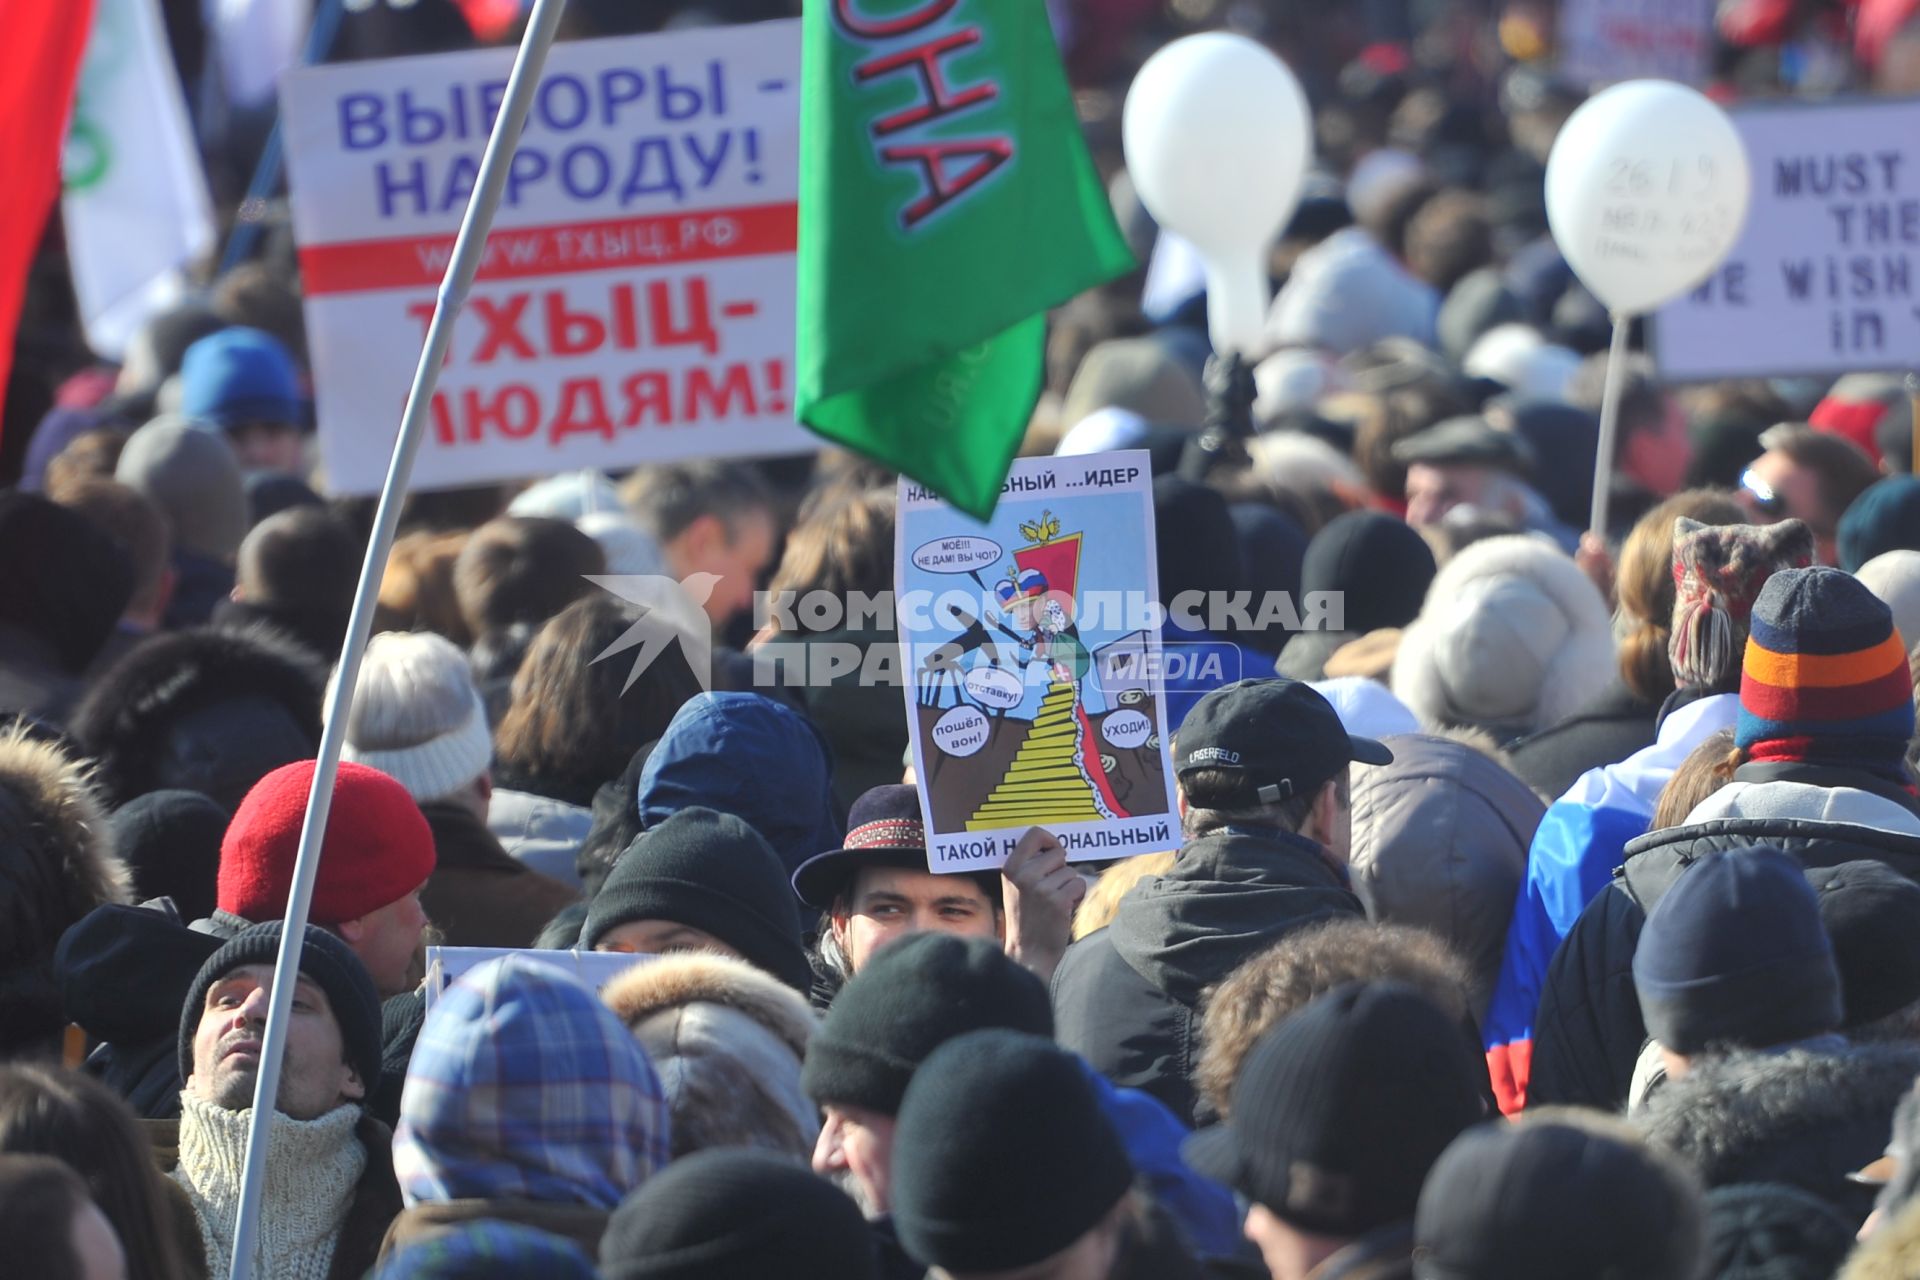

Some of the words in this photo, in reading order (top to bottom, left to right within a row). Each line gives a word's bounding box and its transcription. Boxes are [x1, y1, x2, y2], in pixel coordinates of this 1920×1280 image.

[374, 126, 763, 218] НАРОДУ!
[1774, 151, 1902, 197] MUST
[416, 217, 740, 271] WW.ТХЫЦ.РФ
[907, 470, 1056, 502] НАЦЬНЫЙ
[918, 556, 931, 565] НЕ
[957, 553, 974, 562] ВЫ
[936, 716, 983, 736] пошёл
[951, 732, 982, 749] вон!
[937, 837, 997, 861] ТАКОЙ
[1004, 820, 1170, 855] НОНАЛЬНЫЙ
